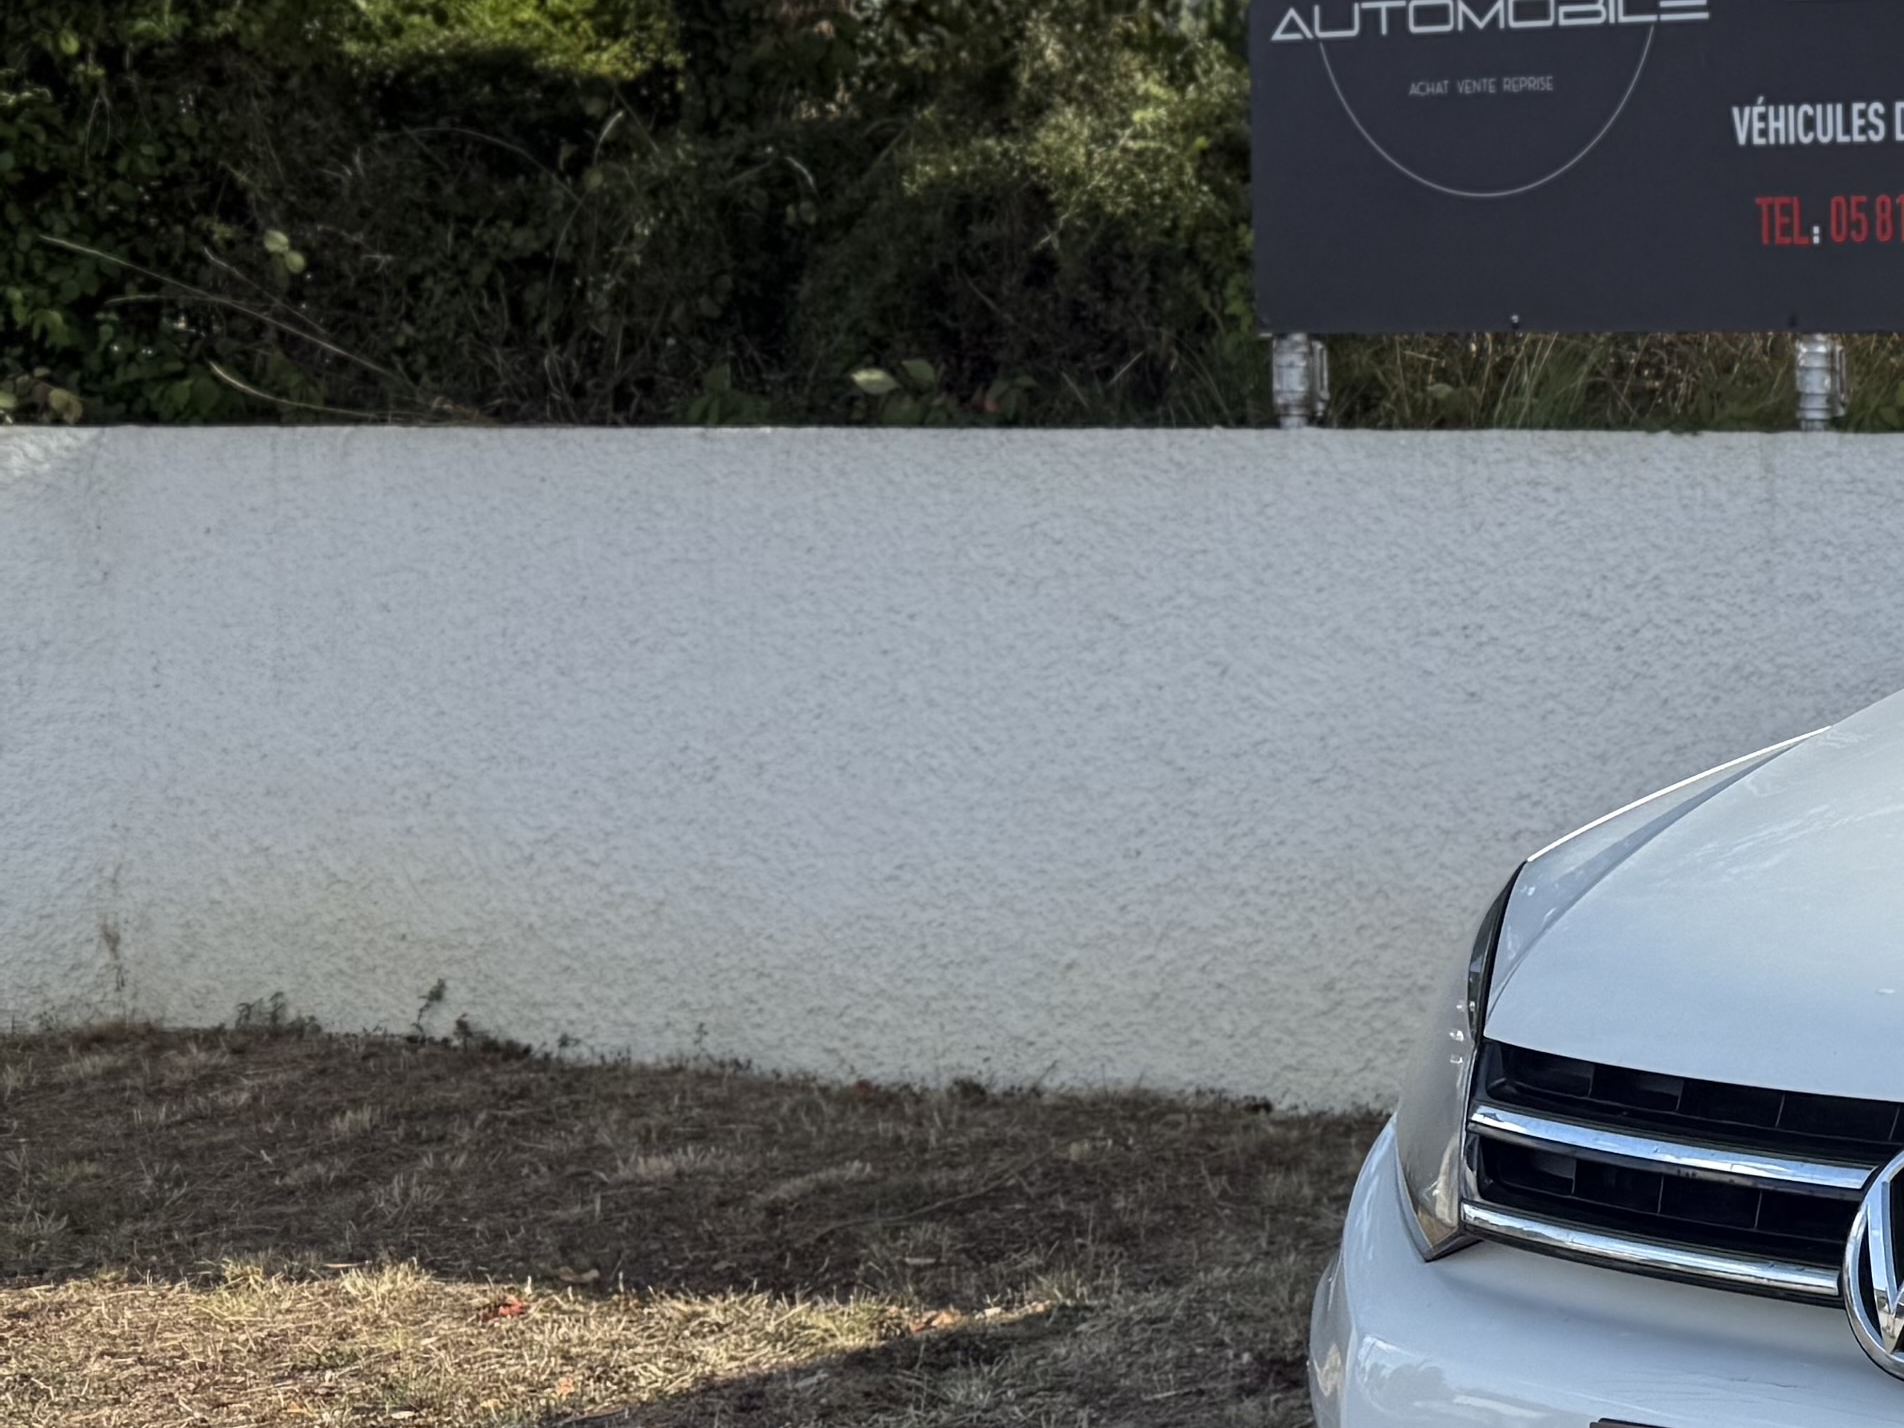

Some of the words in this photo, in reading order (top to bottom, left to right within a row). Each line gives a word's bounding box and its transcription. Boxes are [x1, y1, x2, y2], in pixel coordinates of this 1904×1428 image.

[1408, 79, 1449, 97] ACHAT
[1456, 77, 1497, 95] VENTE
[1502, 75, 1555, 93] REPRISE
[1732, 95, 1886, 146] VÉHICULES
